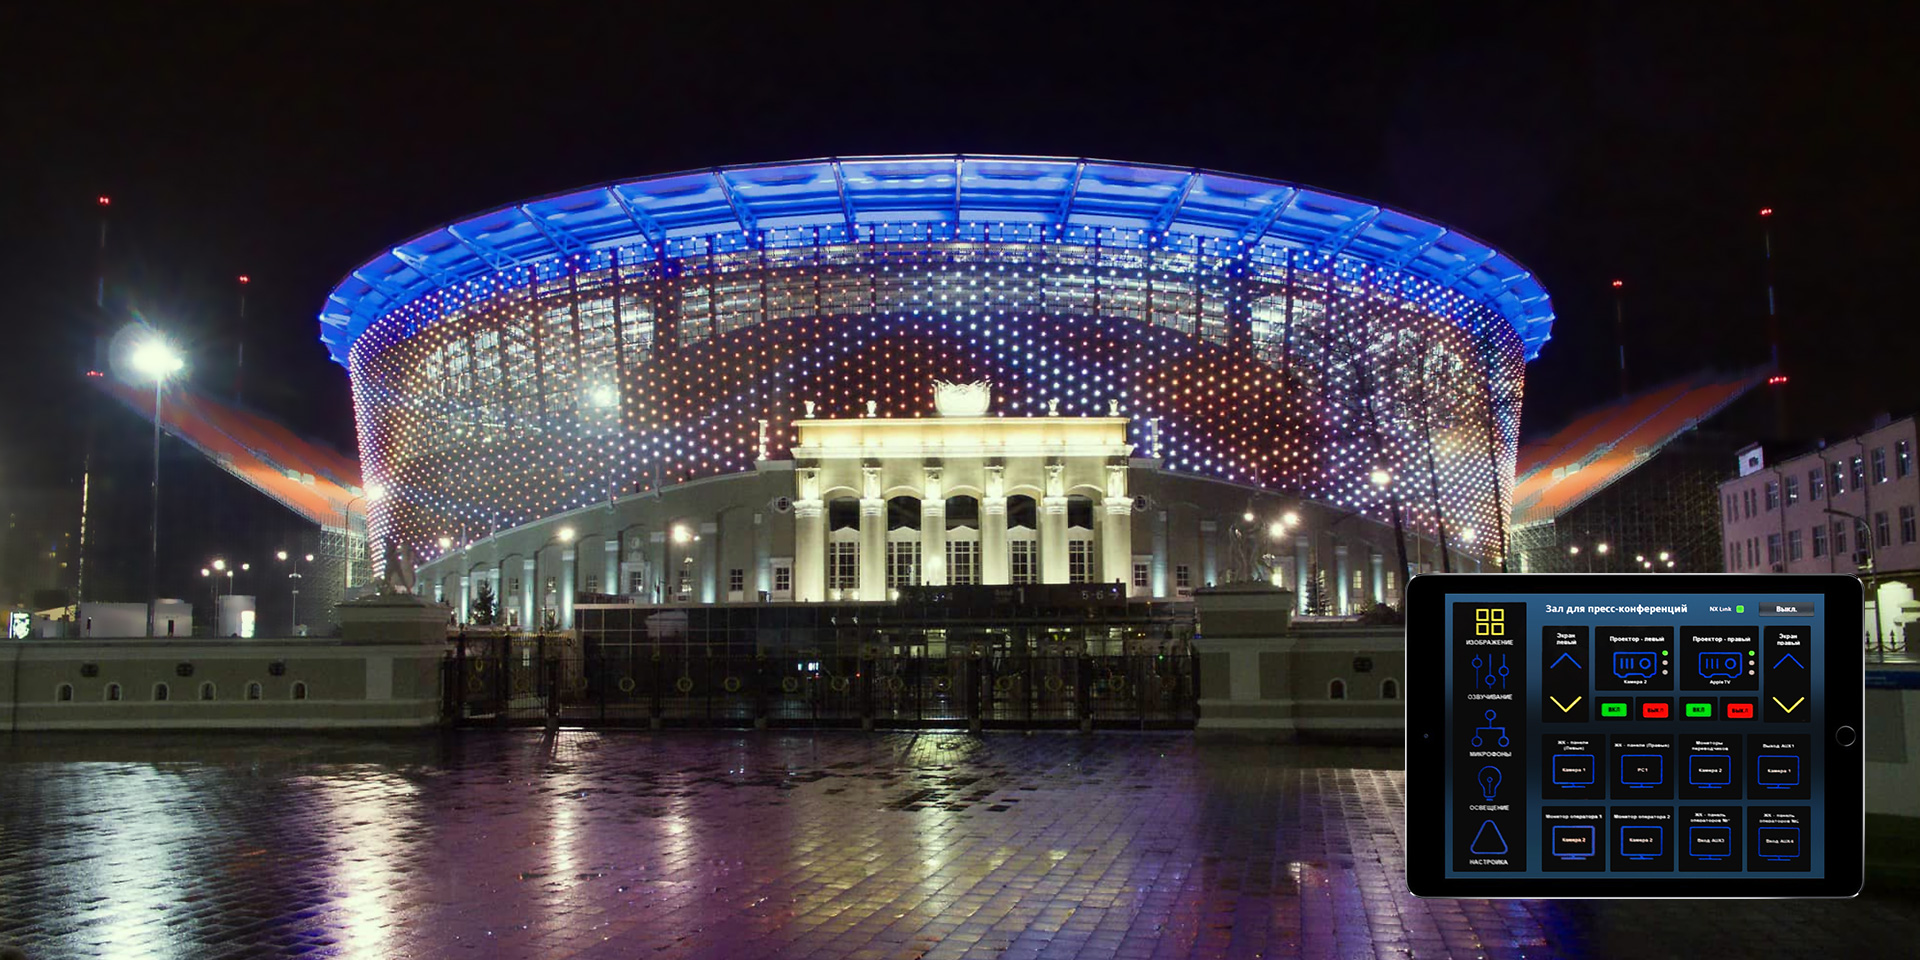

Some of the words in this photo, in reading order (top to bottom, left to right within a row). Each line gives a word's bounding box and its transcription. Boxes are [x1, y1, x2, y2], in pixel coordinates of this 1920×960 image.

[1017, 587, 1025, 604] 1
[1546, 604, 1564, 612] Зал
[1566, 605, 1586, 614] для
[1588, 603, 1688, 615] пресс-конференций
[1775, 605, 1798, 613] Выкл.
[1556, 632, 1576, 640] Экран
[1609, 635, 1640, 643] Проектор
[1693, 635, 1724, 643] Проектор
[1726, 636, 1752, 644] правый
[1779, 632, 1798, 640] Экран
[1467, 693, 1513, 701] ОЗВУЧИВАНИЕ
[1469, 750, 1513, 758] МИКРОФОНЫ
[1468, 804, 1510, 812] ОСВЕЩЕНИЕ
[1469, 858, 1509, 866] НАСТРОЙКА
